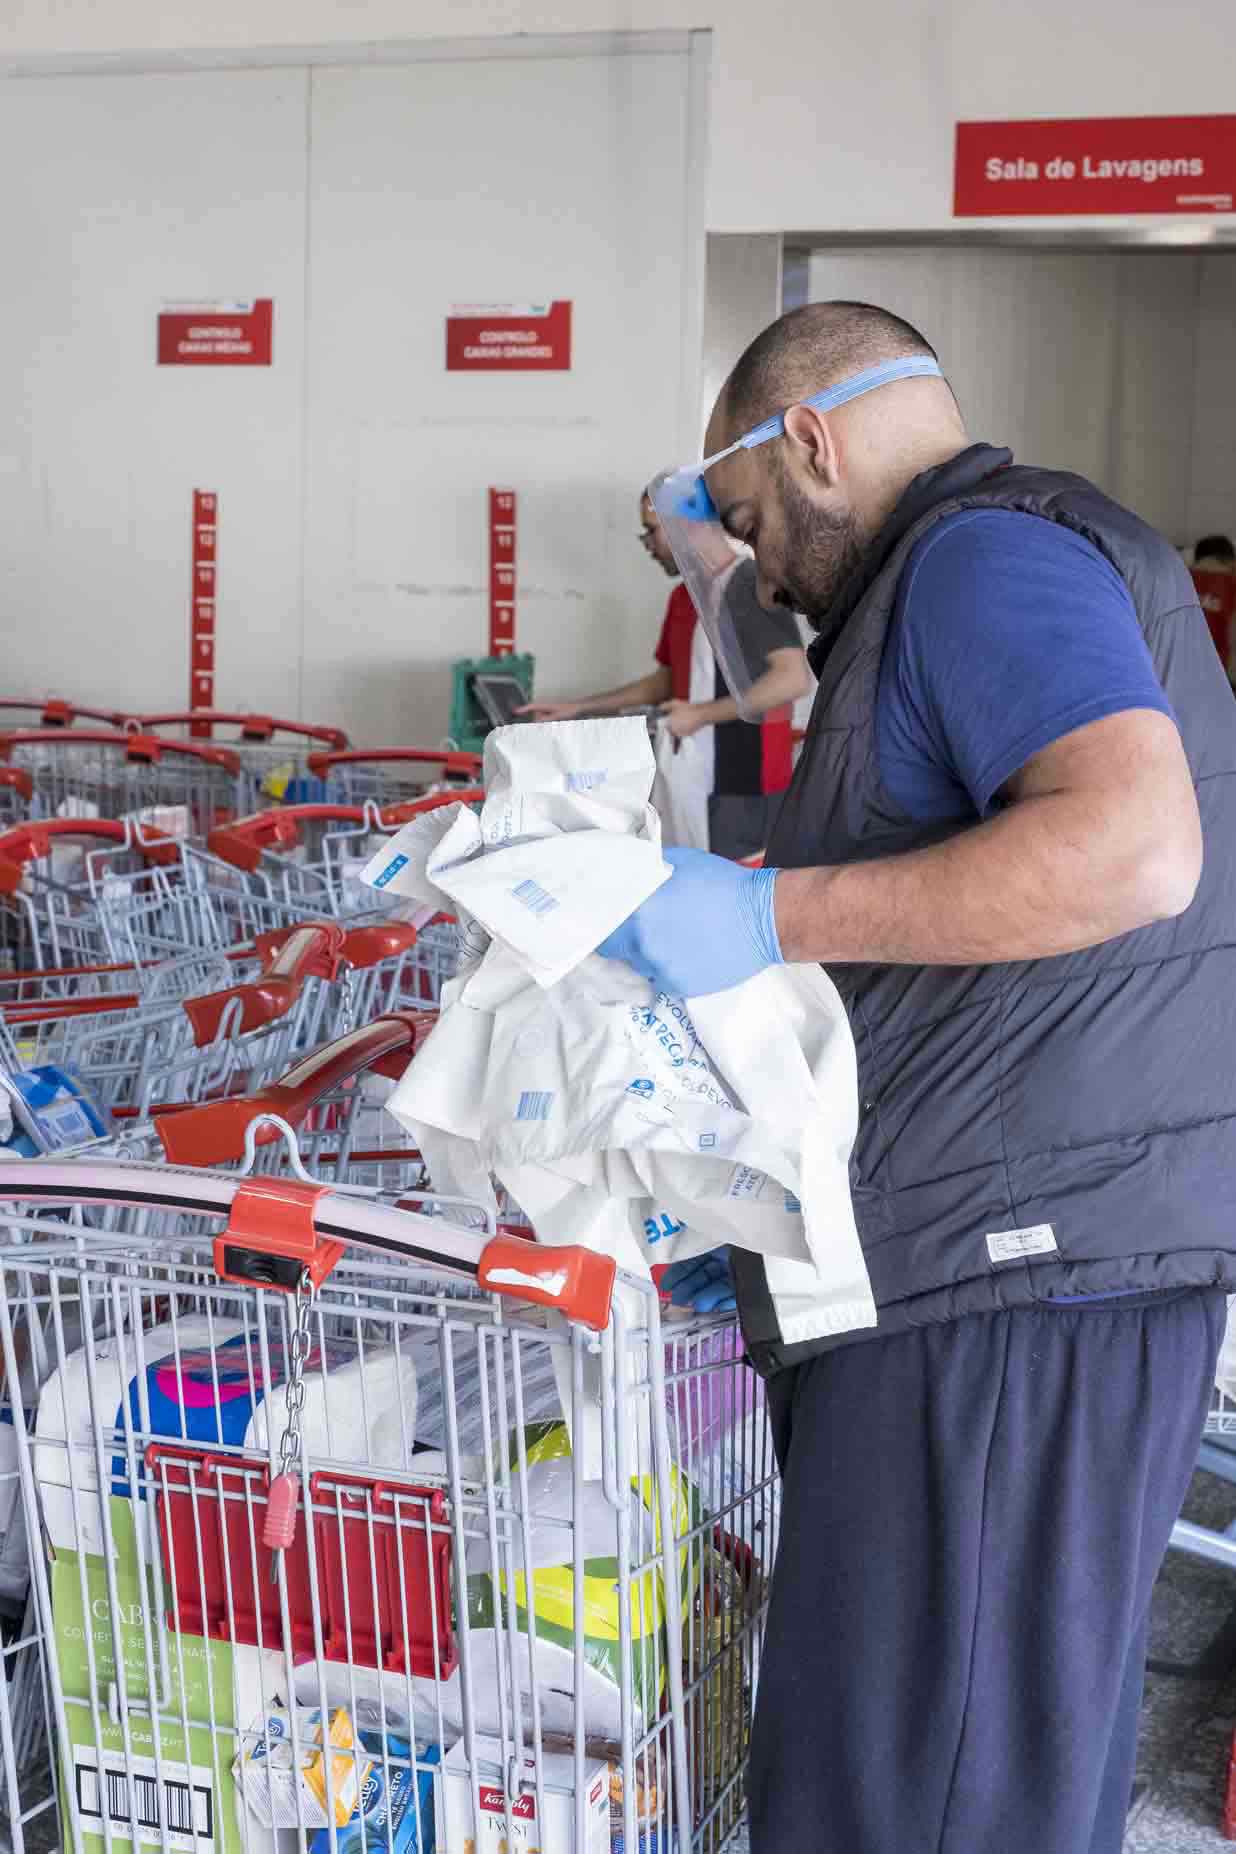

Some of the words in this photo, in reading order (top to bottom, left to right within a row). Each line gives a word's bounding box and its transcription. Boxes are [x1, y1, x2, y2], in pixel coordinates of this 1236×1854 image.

[985, 157, 1039, 181] Sala
[1045, 156, 1075, 180] de
[1082, 155, 1204, 183] Lavagens
